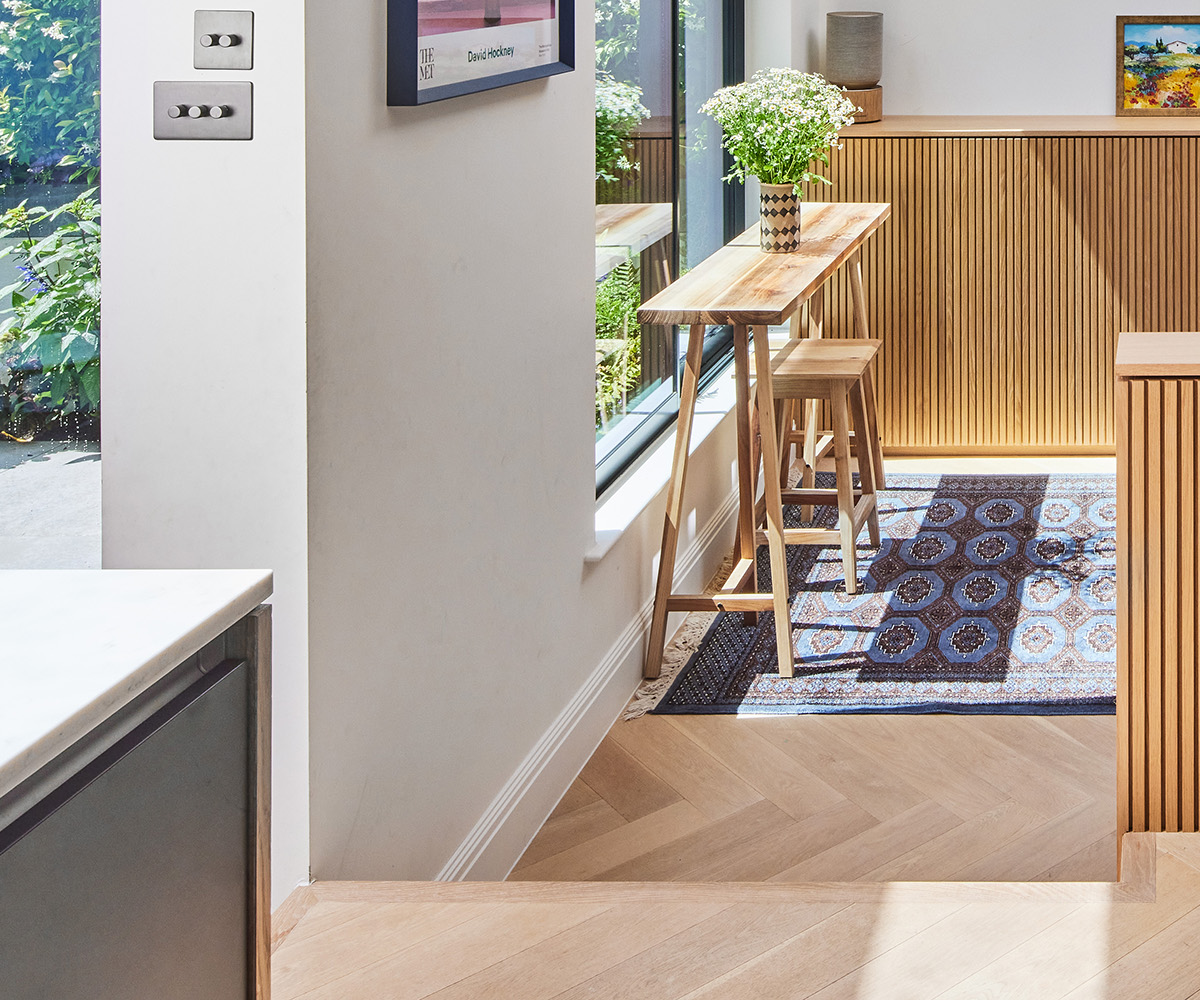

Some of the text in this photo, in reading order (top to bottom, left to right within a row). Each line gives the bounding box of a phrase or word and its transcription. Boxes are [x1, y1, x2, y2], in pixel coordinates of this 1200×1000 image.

[419, 47, 435, 64] THE
[467, 45, 515, 63] David Hockney
